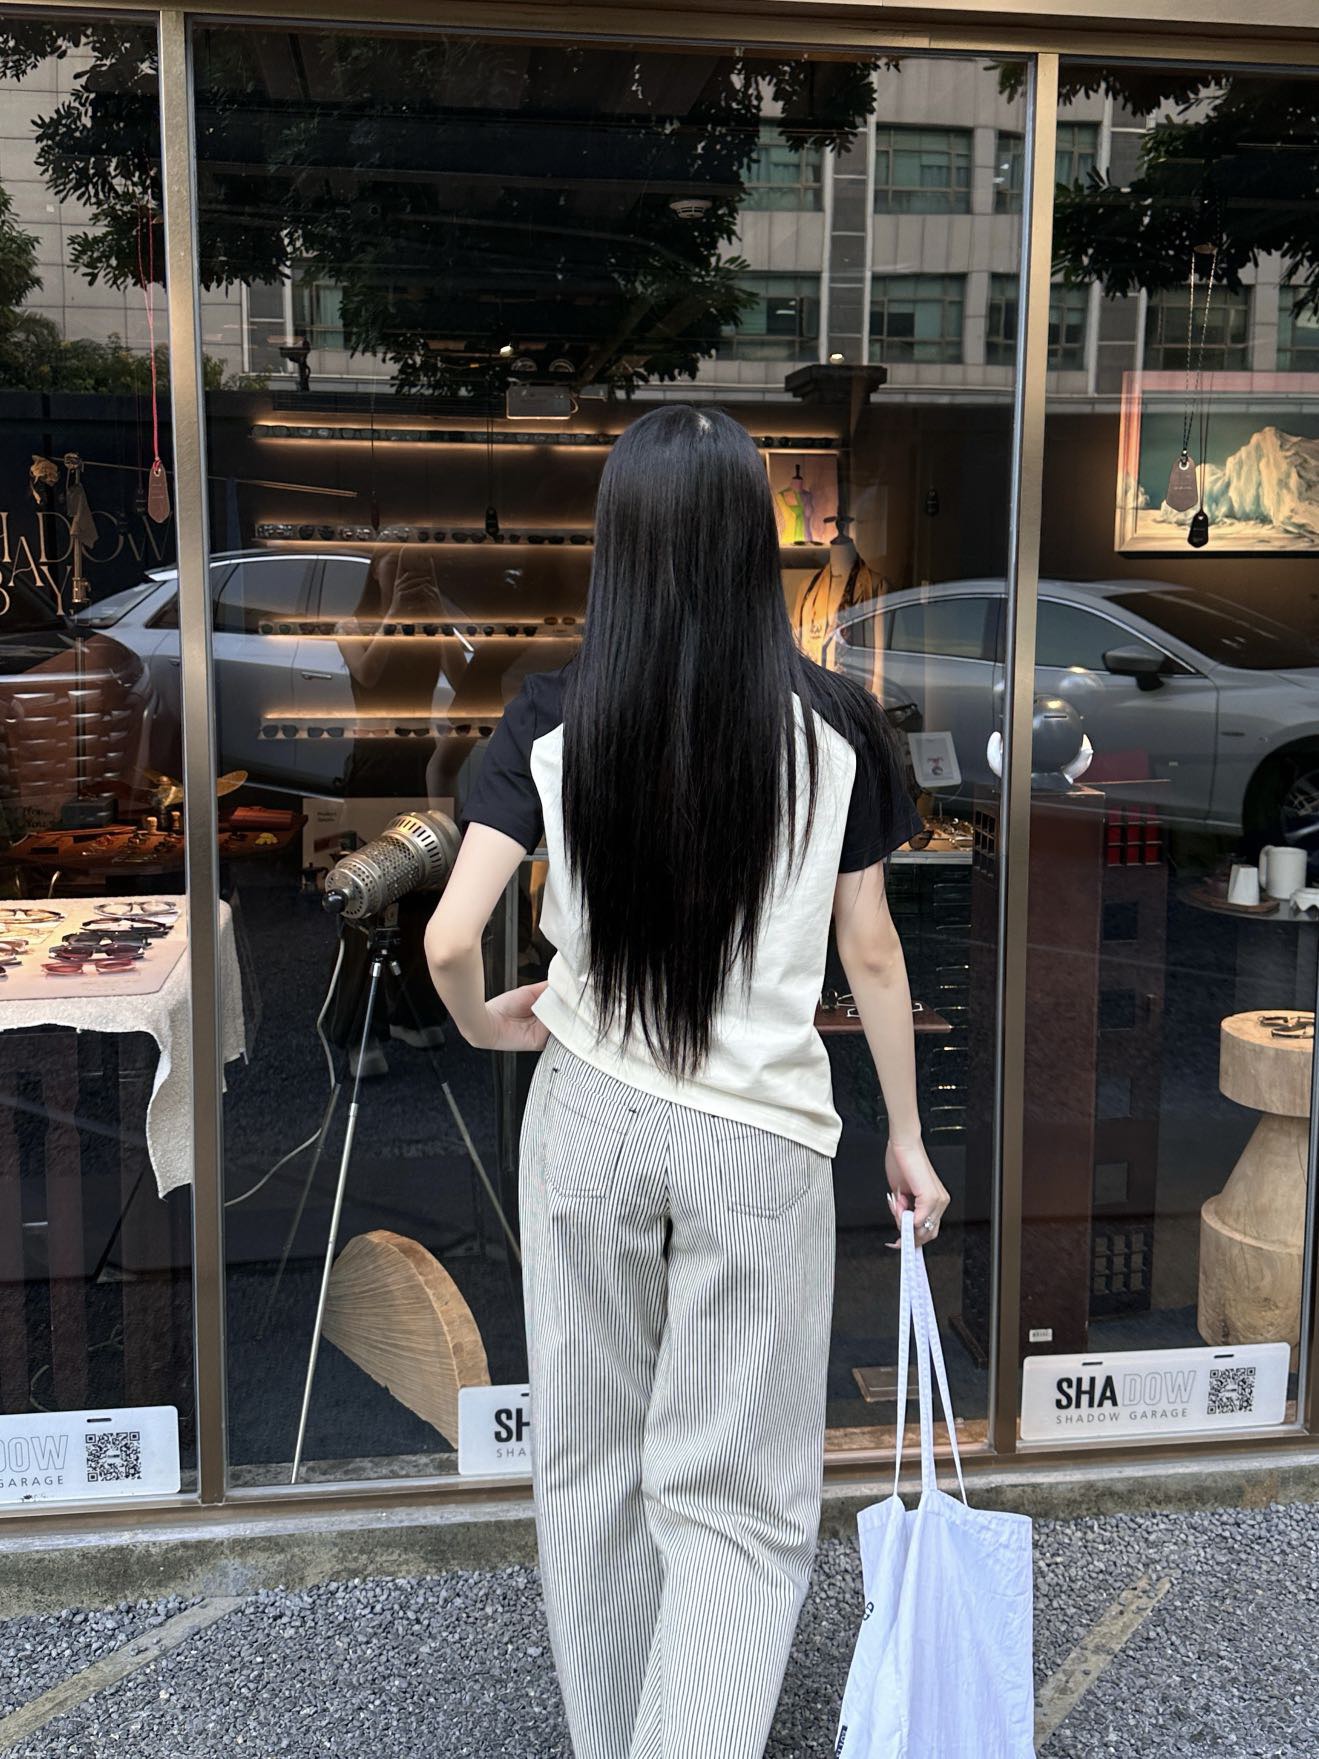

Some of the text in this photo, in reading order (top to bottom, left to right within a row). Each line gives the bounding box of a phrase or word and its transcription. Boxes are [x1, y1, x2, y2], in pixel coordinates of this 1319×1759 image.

[1055, 1370, 1198, 1410] SHADOW
[1056, 1408, 1189, 1425] SHADOW GARAGE
[0, 1435, 69, 1473] OW
